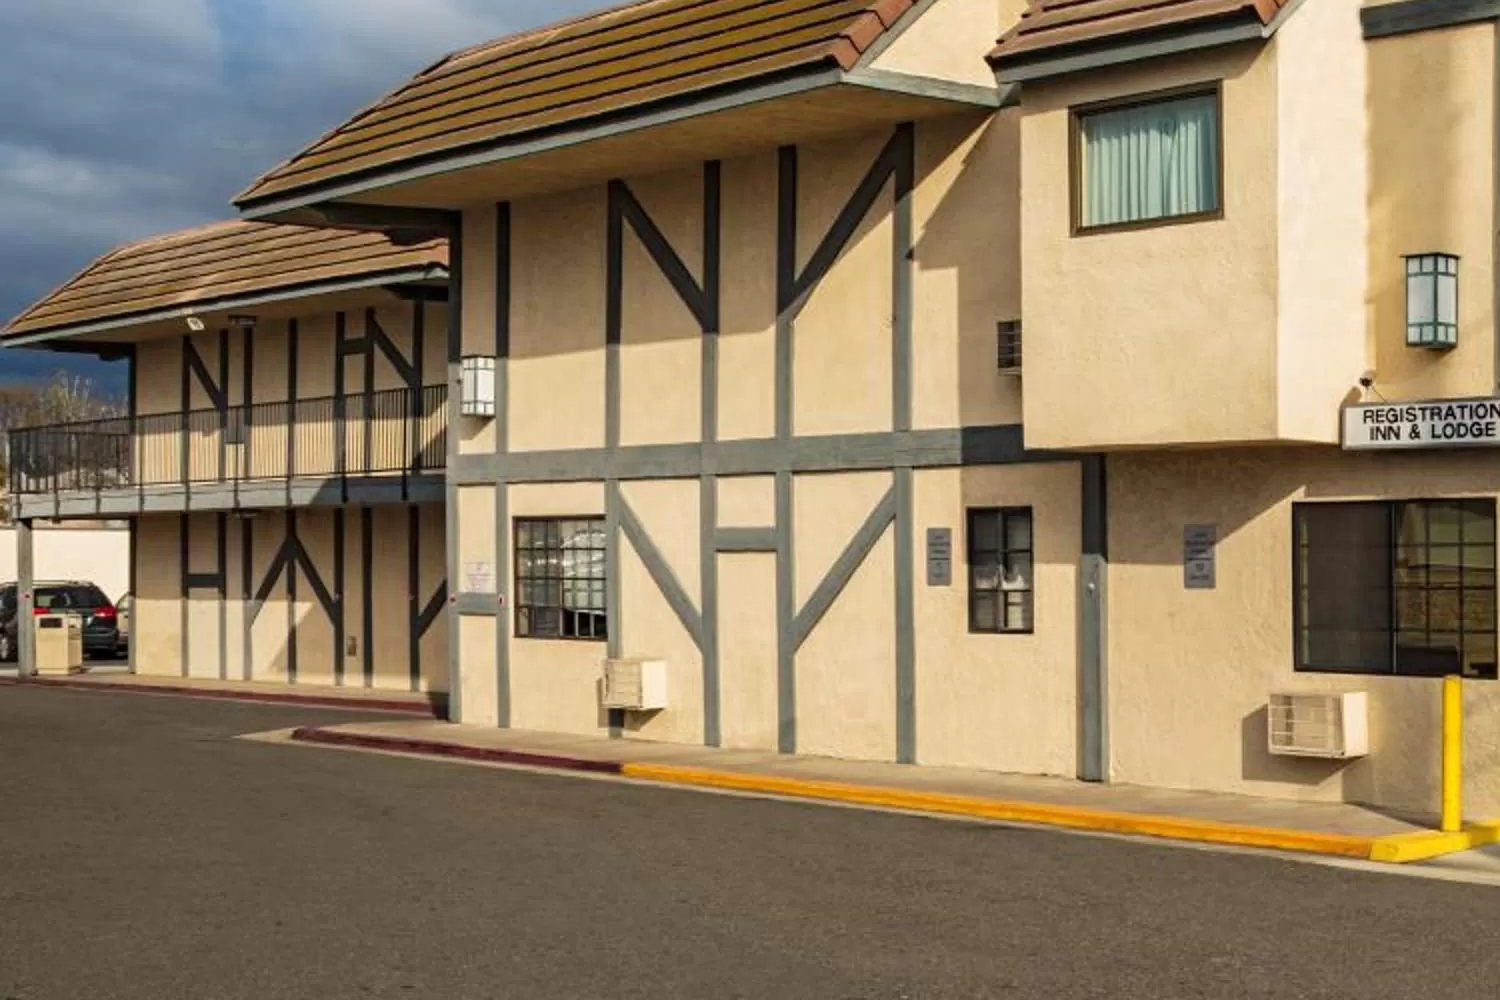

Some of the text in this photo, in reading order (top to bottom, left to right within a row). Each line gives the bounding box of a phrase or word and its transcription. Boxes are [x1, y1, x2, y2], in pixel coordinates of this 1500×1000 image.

[1369, 422, 1497, 441] INN & LODGE
